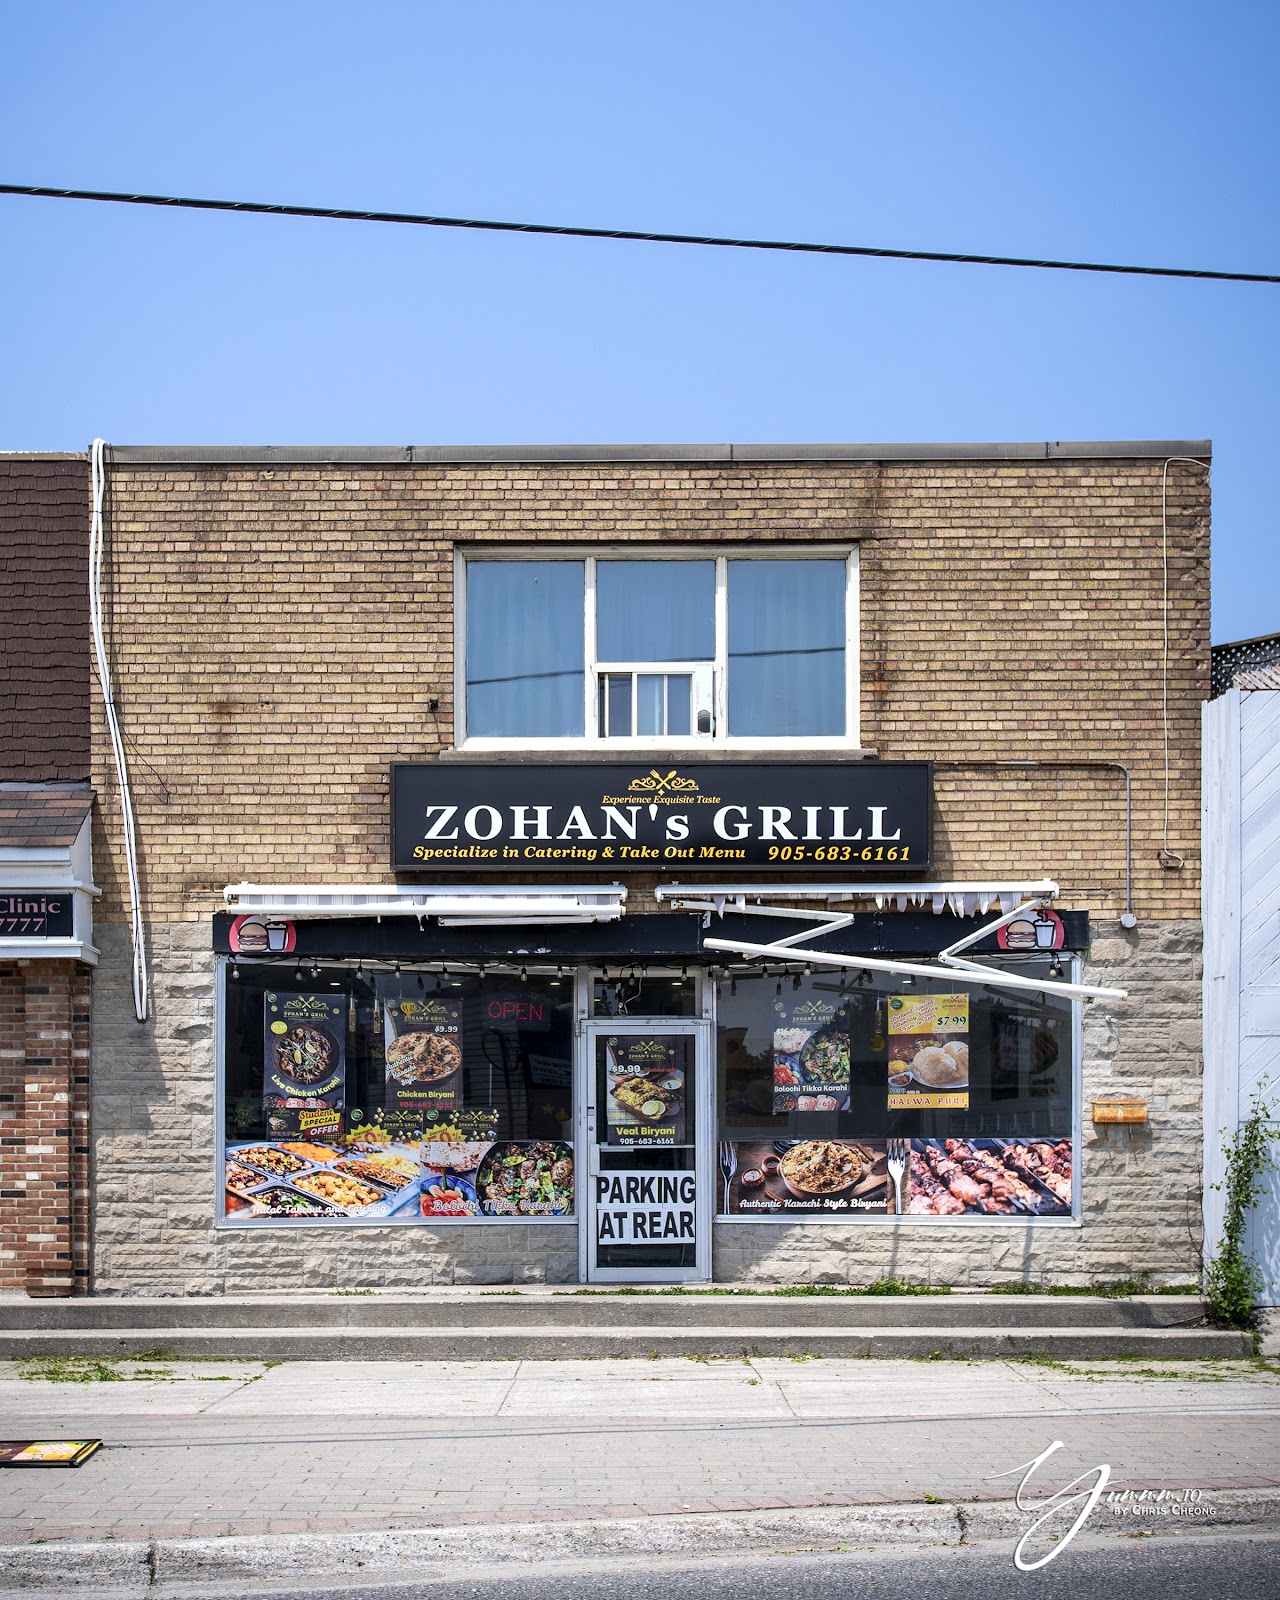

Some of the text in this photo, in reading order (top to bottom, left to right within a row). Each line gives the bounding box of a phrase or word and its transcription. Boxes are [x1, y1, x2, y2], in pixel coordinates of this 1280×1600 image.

[602, 795, 721, 805] Experience Exquisite Taste
[424, 804, 901, 841] ZOHAN's GRILL
[413, 846, 911, 861] Specialize in Catering & Take Out Menu 905-683-6161
[488, 1001, 543, 1021] OPEN
[434, 1025, 458, 1033] $9.99
[386, 1055, 413, 1071] Authentic
[611, 1064, 641, 1073] $9.99
[392, 1064, 417, 1079] Karachi
[271, 1074, 341, 1097] Live Chicken Karahi
[401, 1075, 418, 1086] Style
[802, 1084, 822, 1092] Tikka
[823, 1083, 848, 1092] Karahi
[428, 1091, 455, 1100] Biryani
[890, 1096, 966, 1106] HALWA PURI
[399, 1101, 453, 1109] 905-683-6161
[299, 1108, 334, 1120] Student
[303, 1116, 337, 1127] SPECIAL
[310, 1125, 339, 1136] OFFER
[616, 1126, 675, 1137] Veal Biryani
[619, 1137, 675, 1145] 905-683-6161
[597, 1176, 695, 1204] PARKING
[252, 1204, 387, 1215] Halal Takeout and Catering
[483, 1199, 518, 1212] Tikka
[520, 1199, 563, 1212] Karahi
[739, 1198, 888, 1210] Authentic Karachi Style Biryani
[600, 1211, 695, 1239] AT REAR
